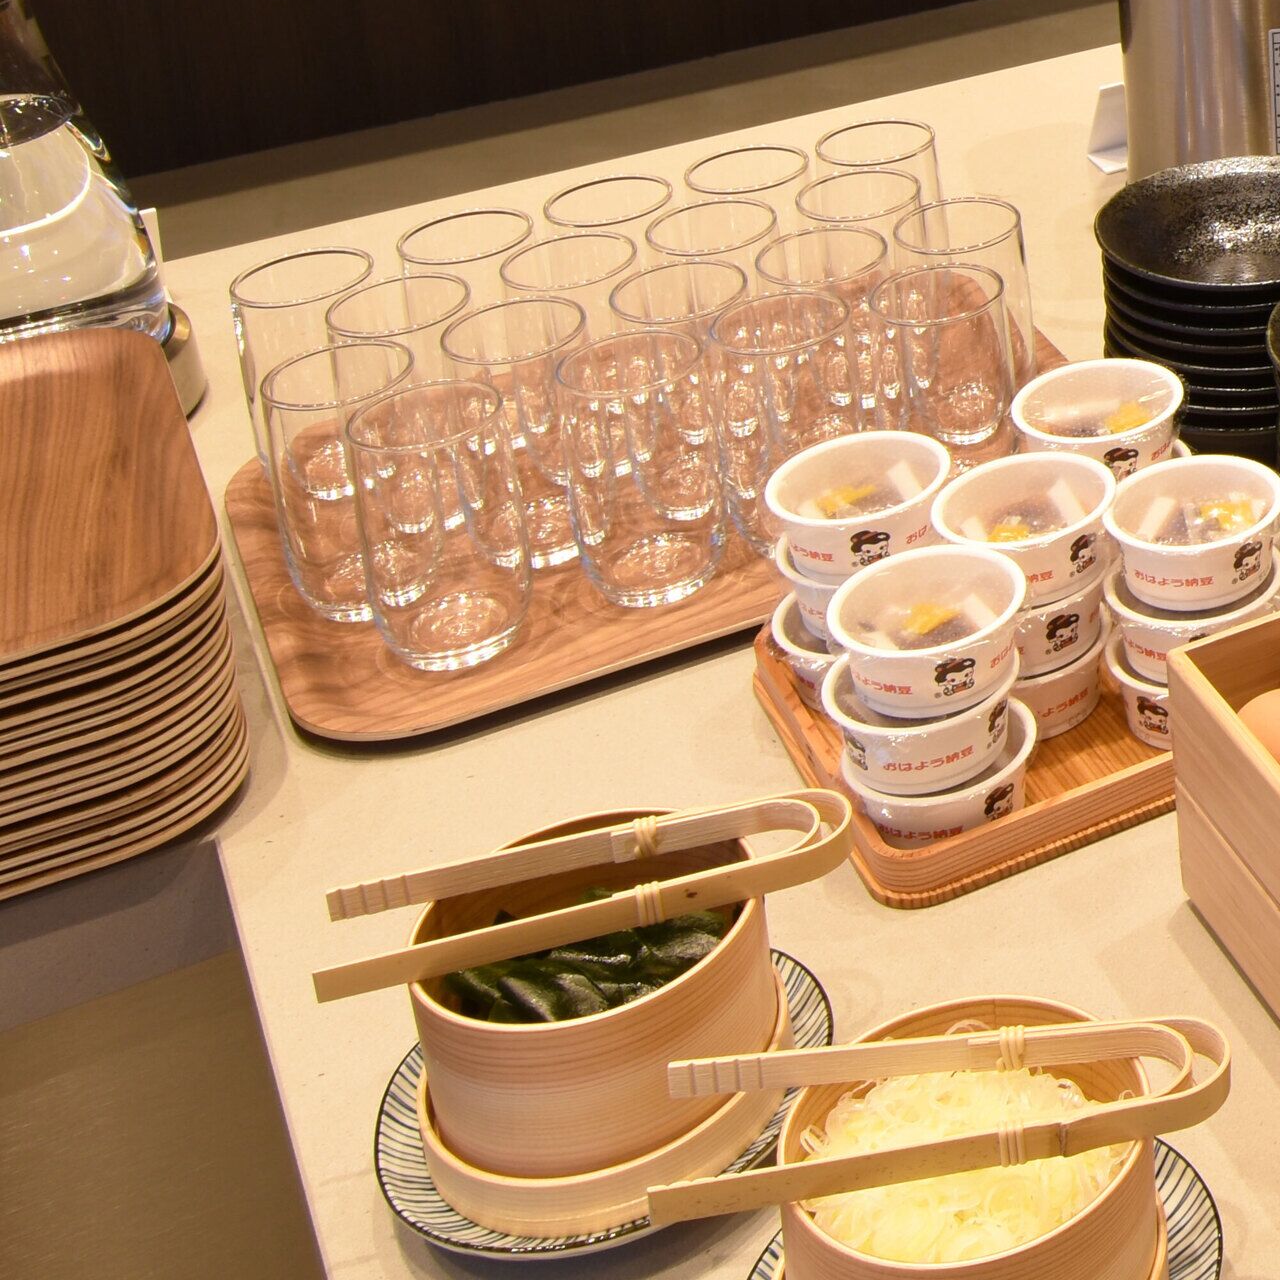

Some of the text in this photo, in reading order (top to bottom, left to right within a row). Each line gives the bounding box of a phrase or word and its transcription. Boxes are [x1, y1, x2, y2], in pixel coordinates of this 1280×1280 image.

[1133, 569, 1215, 588] おはよう納豆
[883, 745, 975, 772] おはよう納豆
